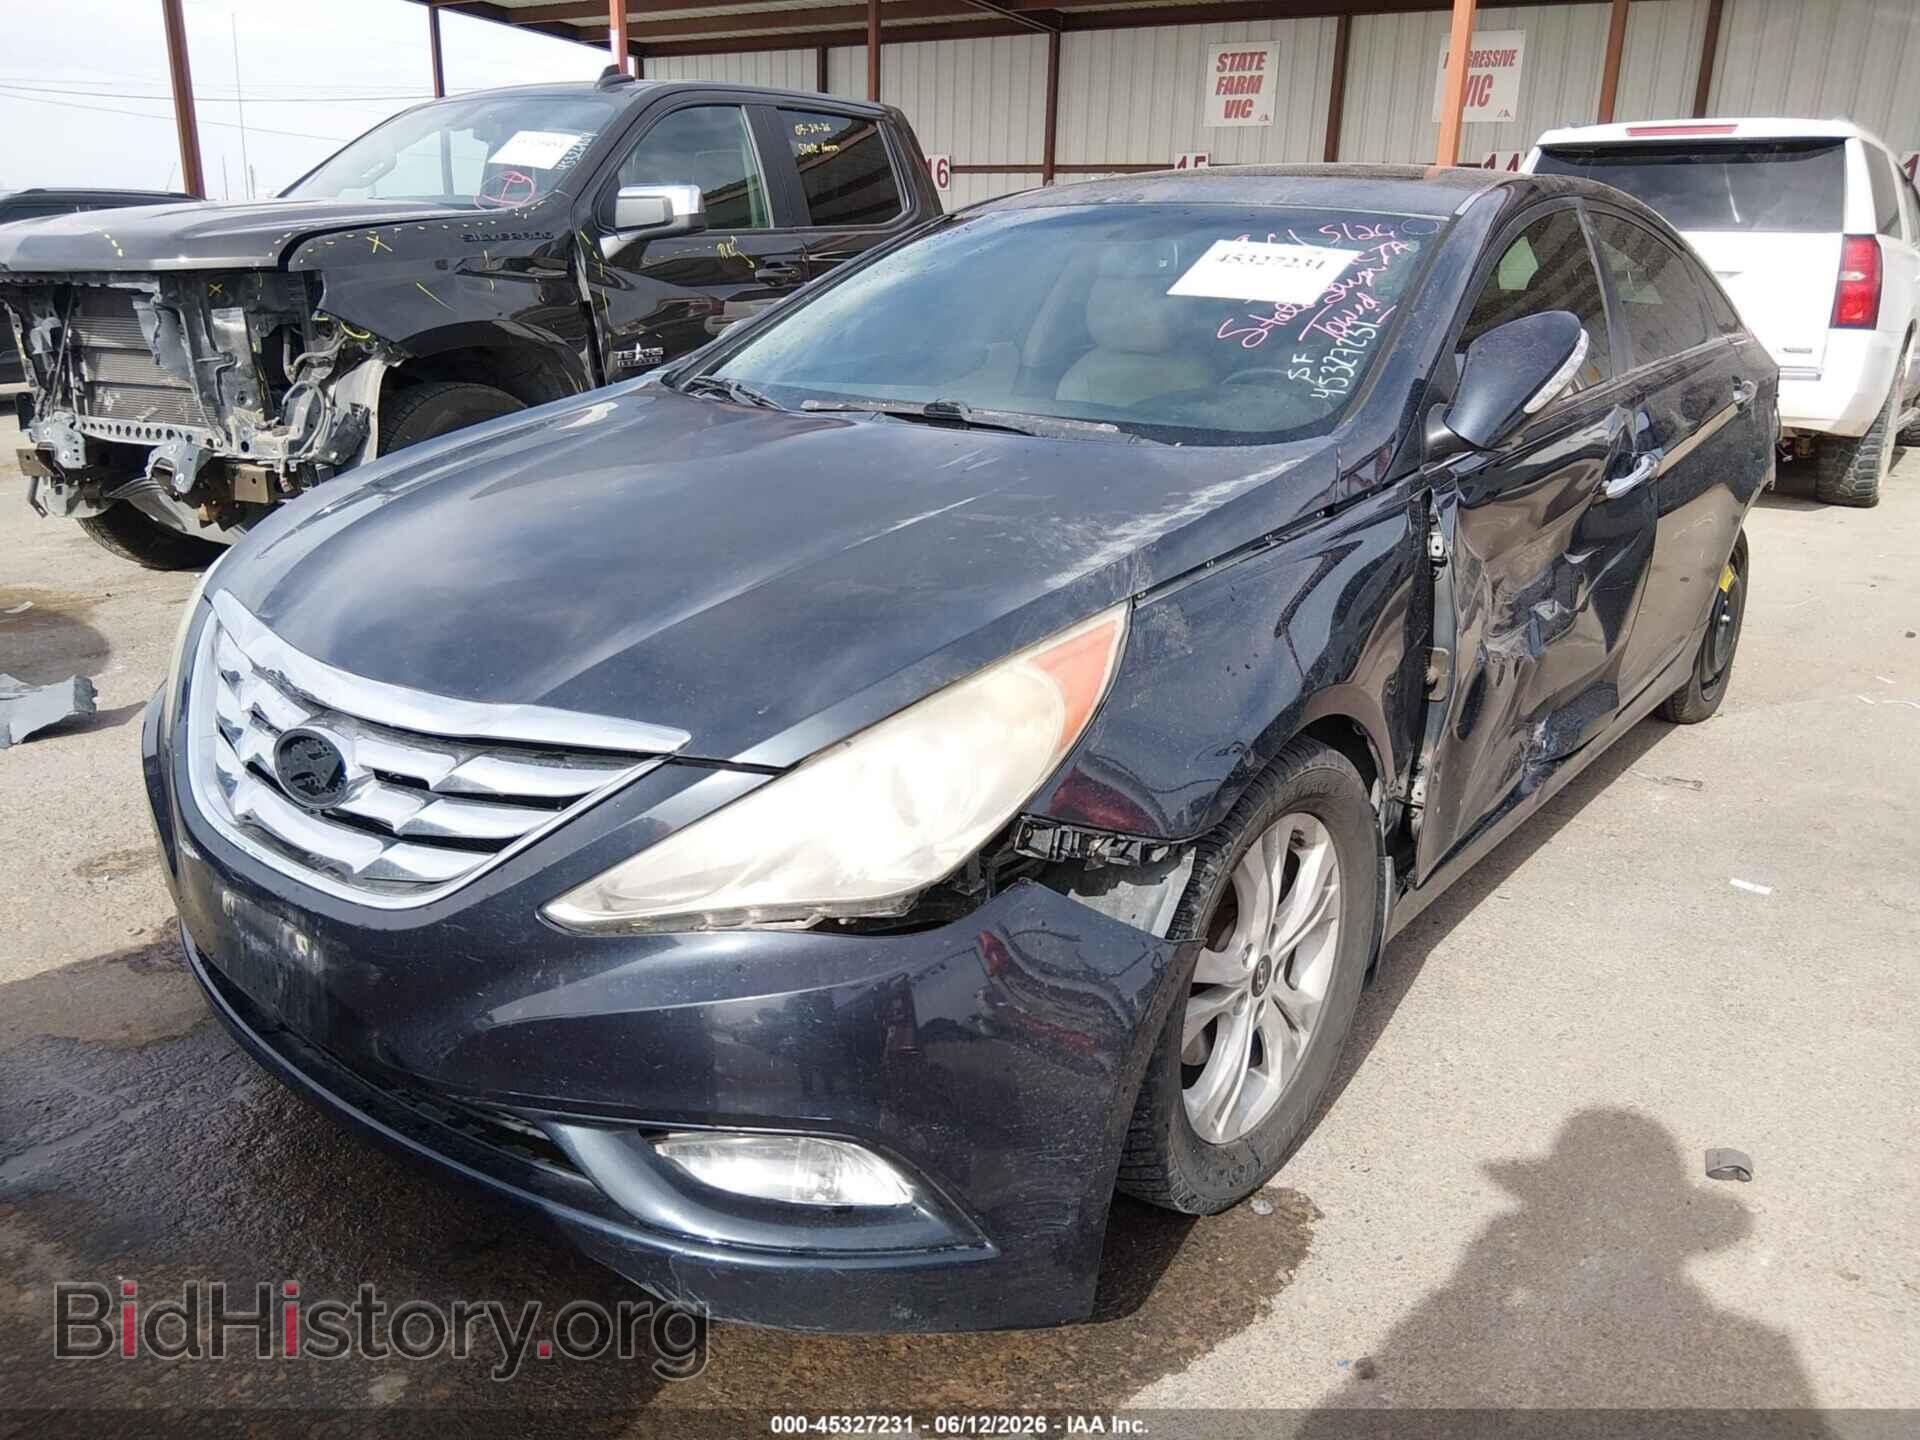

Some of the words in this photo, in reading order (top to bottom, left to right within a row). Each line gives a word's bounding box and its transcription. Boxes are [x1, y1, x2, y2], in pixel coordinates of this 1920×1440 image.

[1215, 51, 1267, 72] STATE
[1215, 75, 1264, 96] FARM
[1223, 98, 1254, 119] VIC
